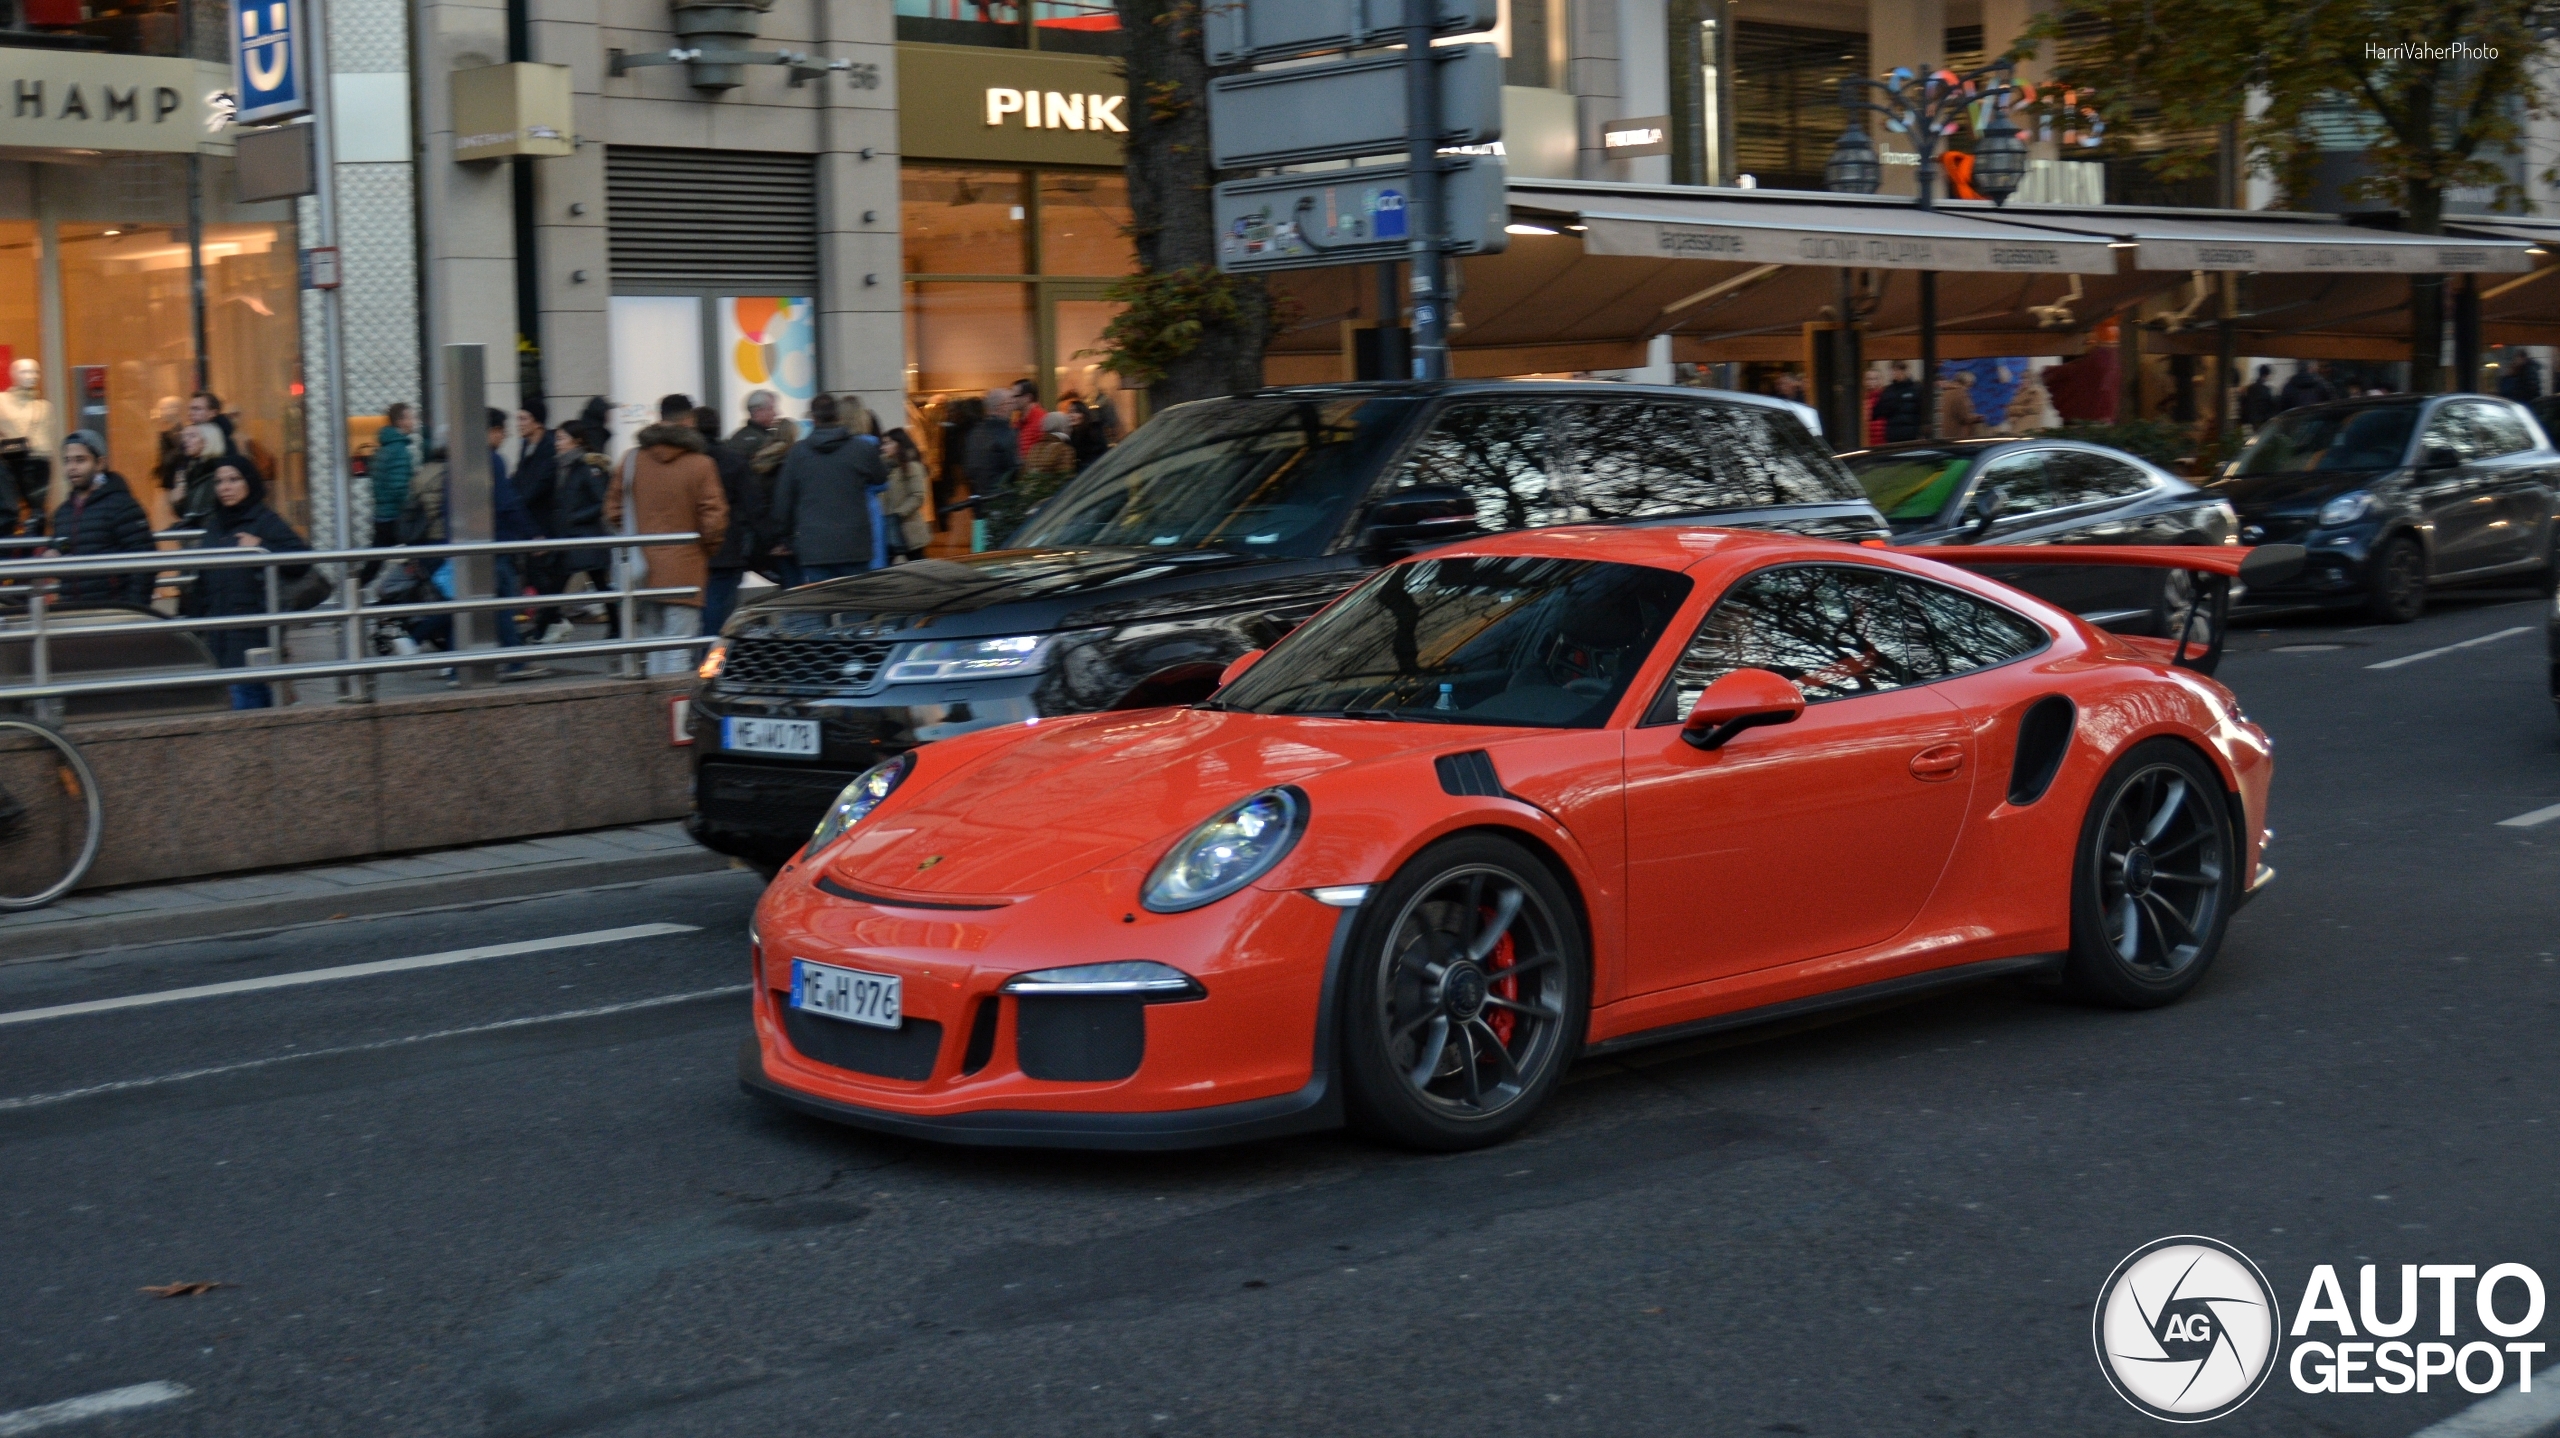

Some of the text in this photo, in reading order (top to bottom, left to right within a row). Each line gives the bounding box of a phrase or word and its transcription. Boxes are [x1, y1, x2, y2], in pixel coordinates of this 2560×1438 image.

[13, 78, 182, 123] HAMP
[985, 88, 1130, 133] PINK
[836, 975, 850, 1013] H
[854, 979, 897, 1020] 976
